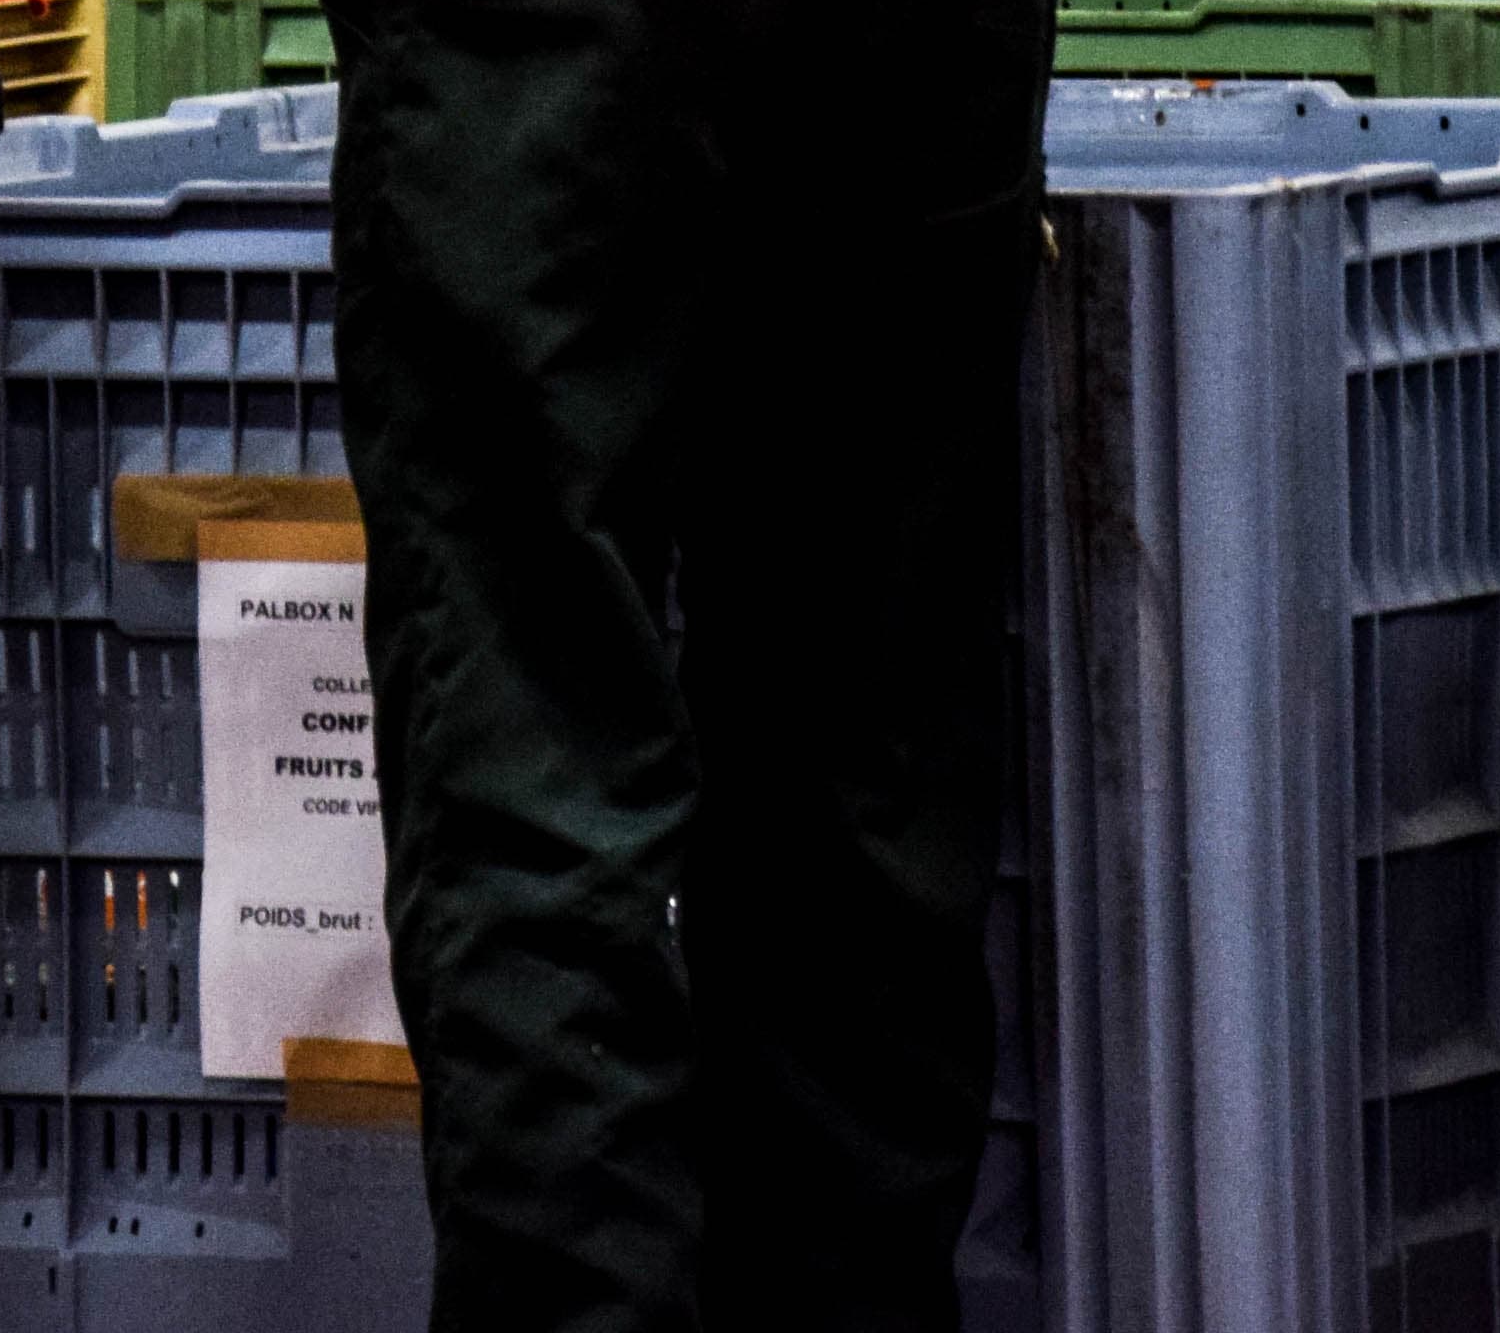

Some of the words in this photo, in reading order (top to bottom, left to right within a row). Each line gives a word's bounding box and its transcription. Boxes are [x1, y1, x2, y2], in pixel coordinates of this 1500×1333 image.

[240, 599, 332, 621] PALBOX
[338, 601, 354, 622] N
[274, 756, 364, 779] FRUITS
[303, 798, 352, 816] CODE
[239, 905, 362, 934] POIDS_brut
